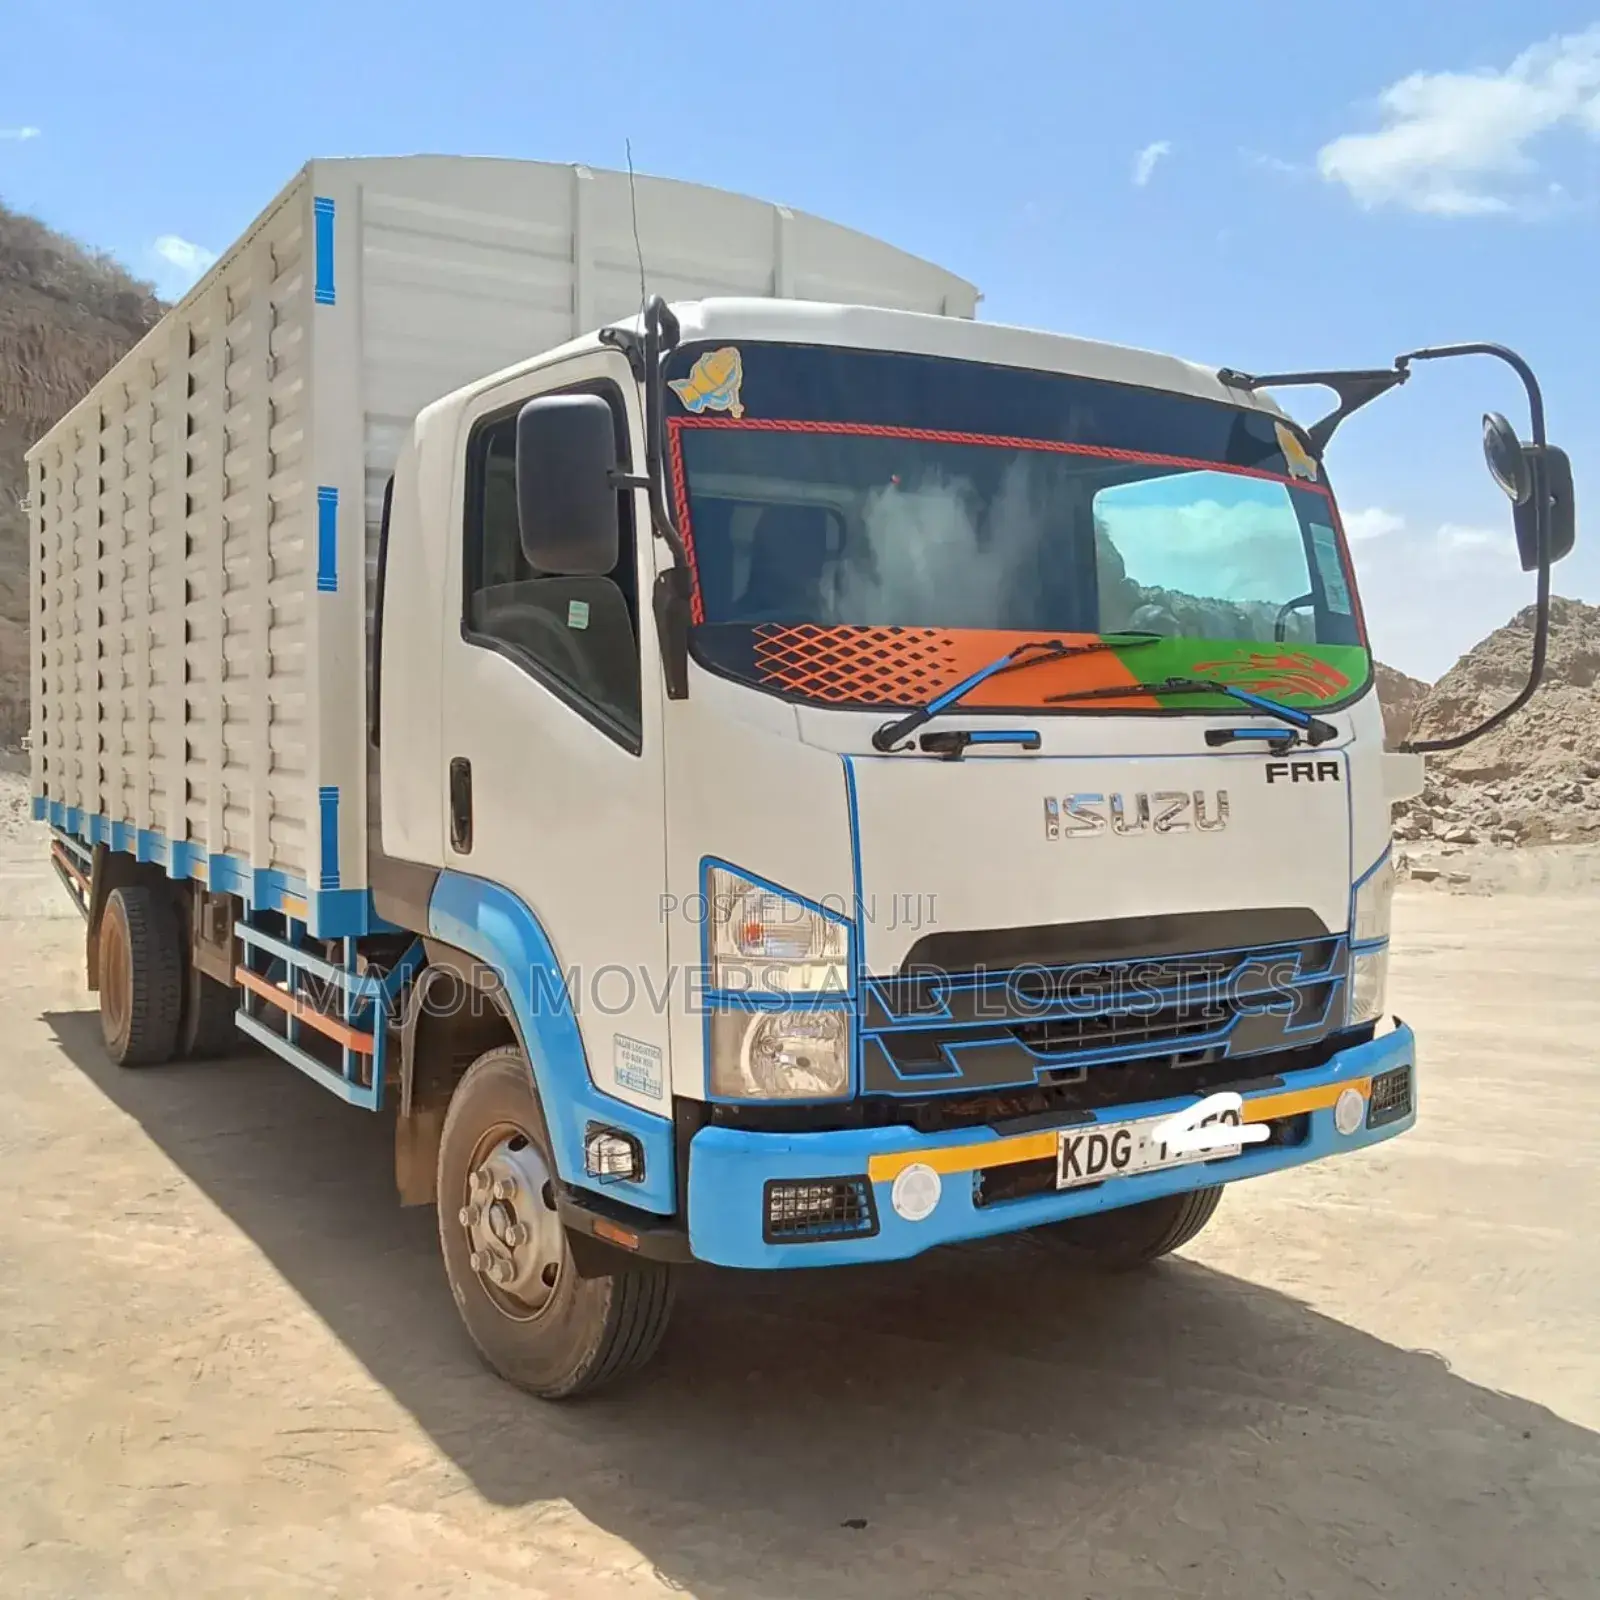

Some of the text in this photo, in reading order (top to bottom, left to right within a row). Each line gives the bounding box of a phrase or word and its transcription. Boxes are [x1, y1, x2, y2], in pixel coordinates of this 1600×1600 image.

[1265, 761, 1340, 783] FRR
[1044, 790, 1230, 841] ISUZU
[1062, 1129, 1131, 1180] KDG
